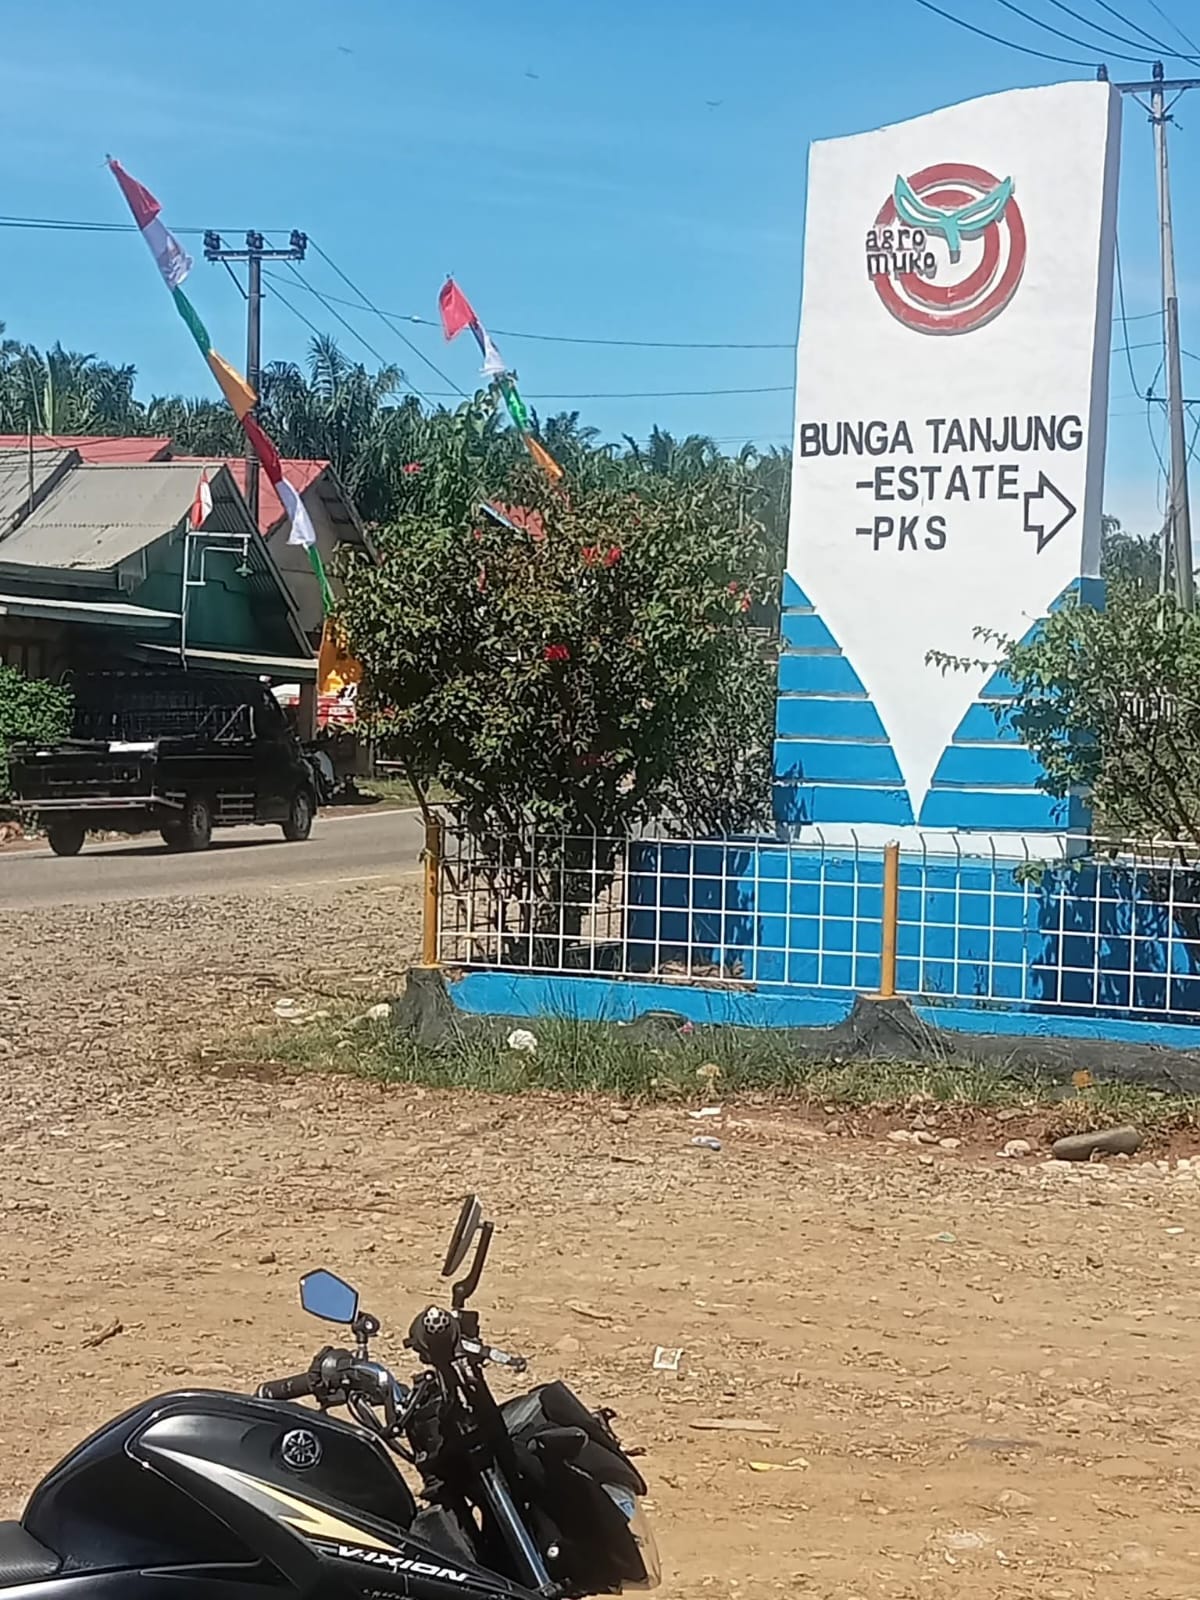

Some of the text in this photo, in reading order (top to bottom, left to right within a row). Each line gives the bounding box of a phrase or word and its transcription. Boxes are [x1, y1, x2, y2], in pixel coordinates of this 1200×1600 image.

[866, 228, 925, 251] agro
[866, 251, 936, 278] muko
[800, 415, 1083, 457] BUNGA TANJUNG
[855, 464, 1019, 501] -ESTATE
[855, 515, 947, 551] -PKS
